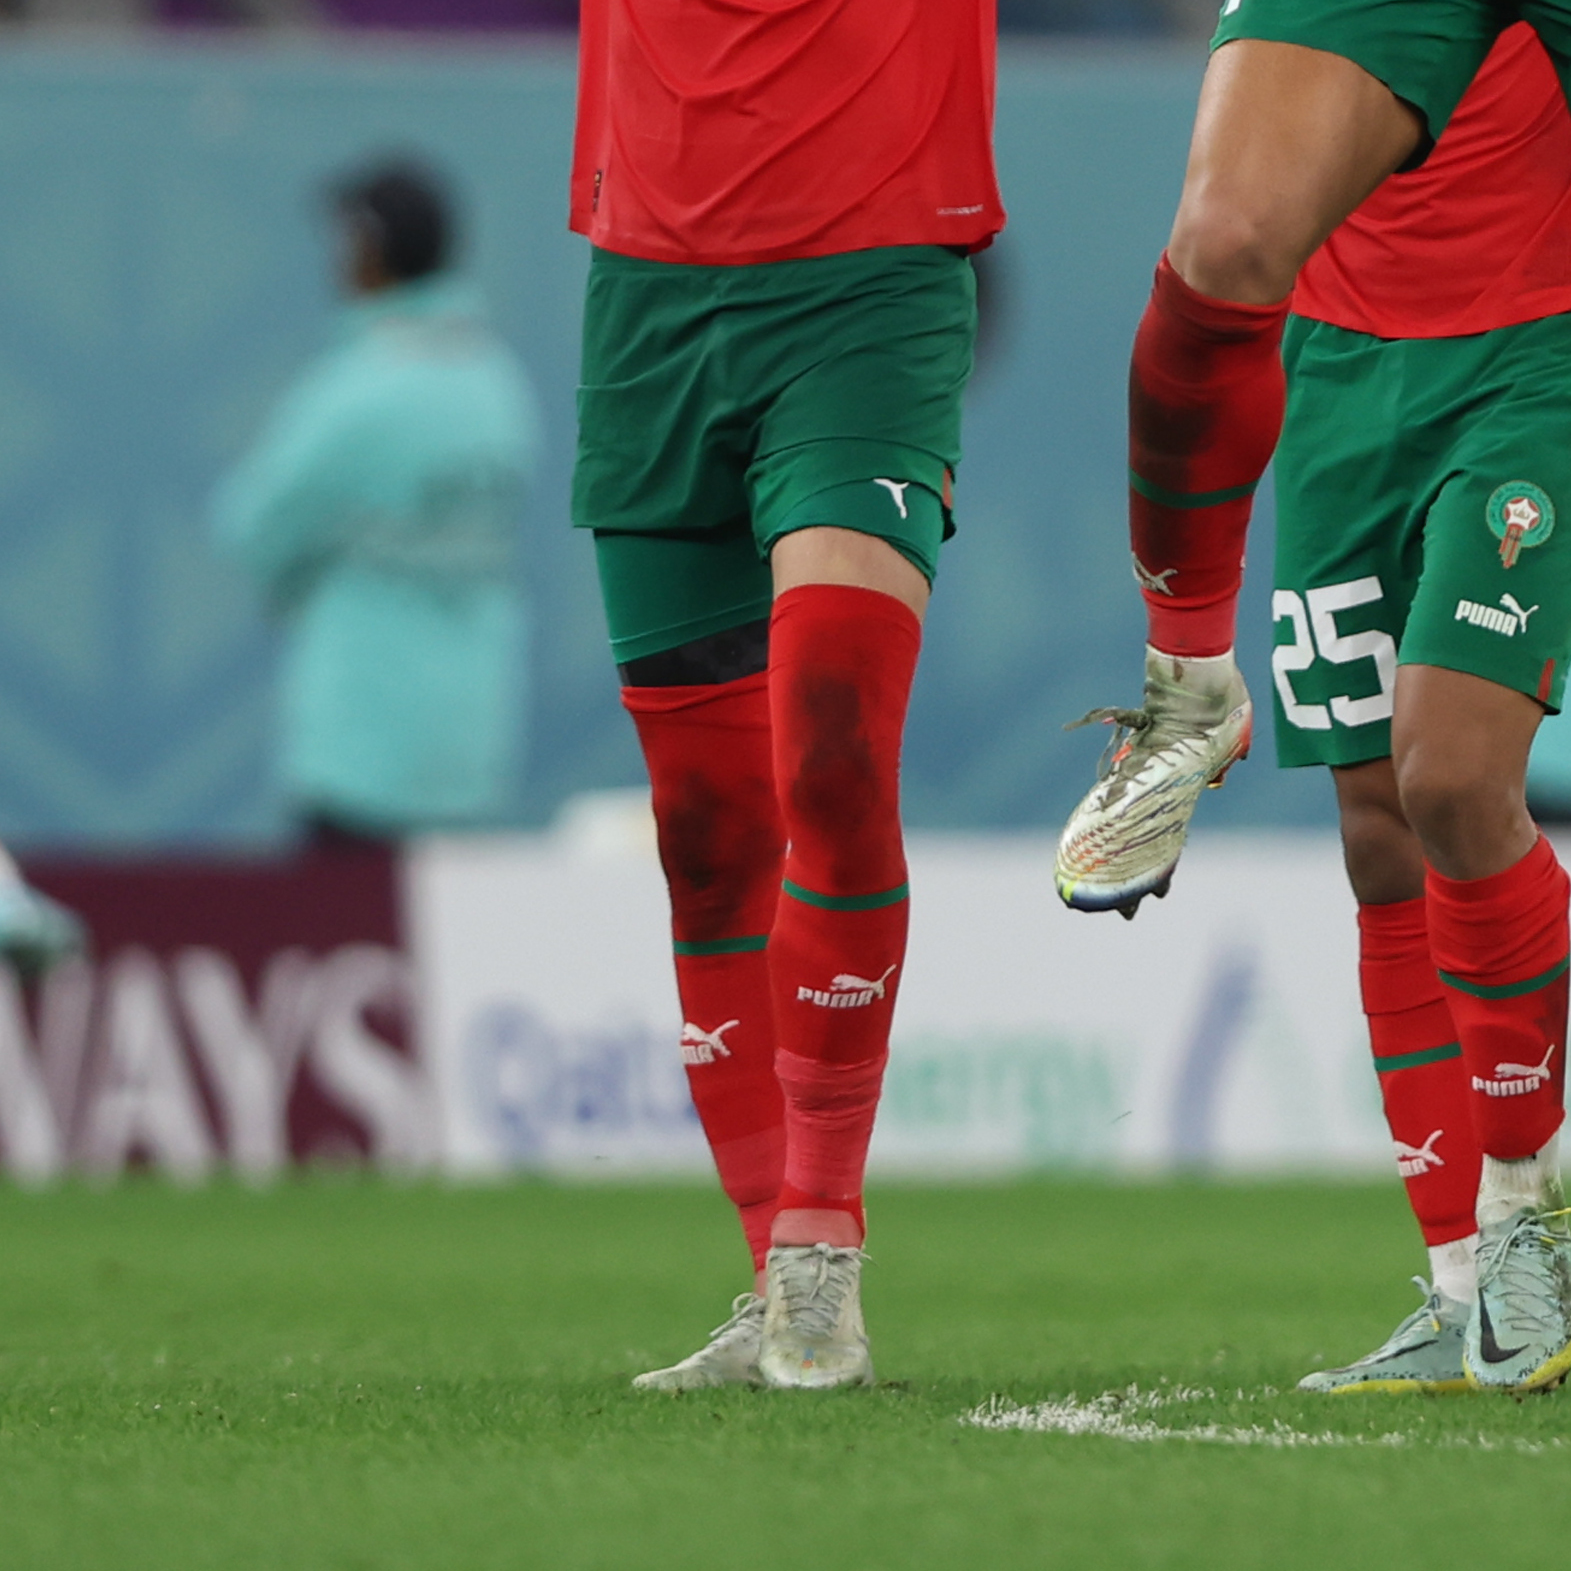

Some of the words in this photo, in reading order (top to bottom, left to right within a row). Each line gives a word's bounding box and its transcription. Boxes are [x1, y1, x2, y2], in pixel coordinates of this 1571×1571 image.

[1455, 600, 1517, 637] PUMA
[1272, 575, 1398, 731] 25
[796, 986, 873, 1008] PUMA
[1470, 1075, 1538, 1098] PUMA
